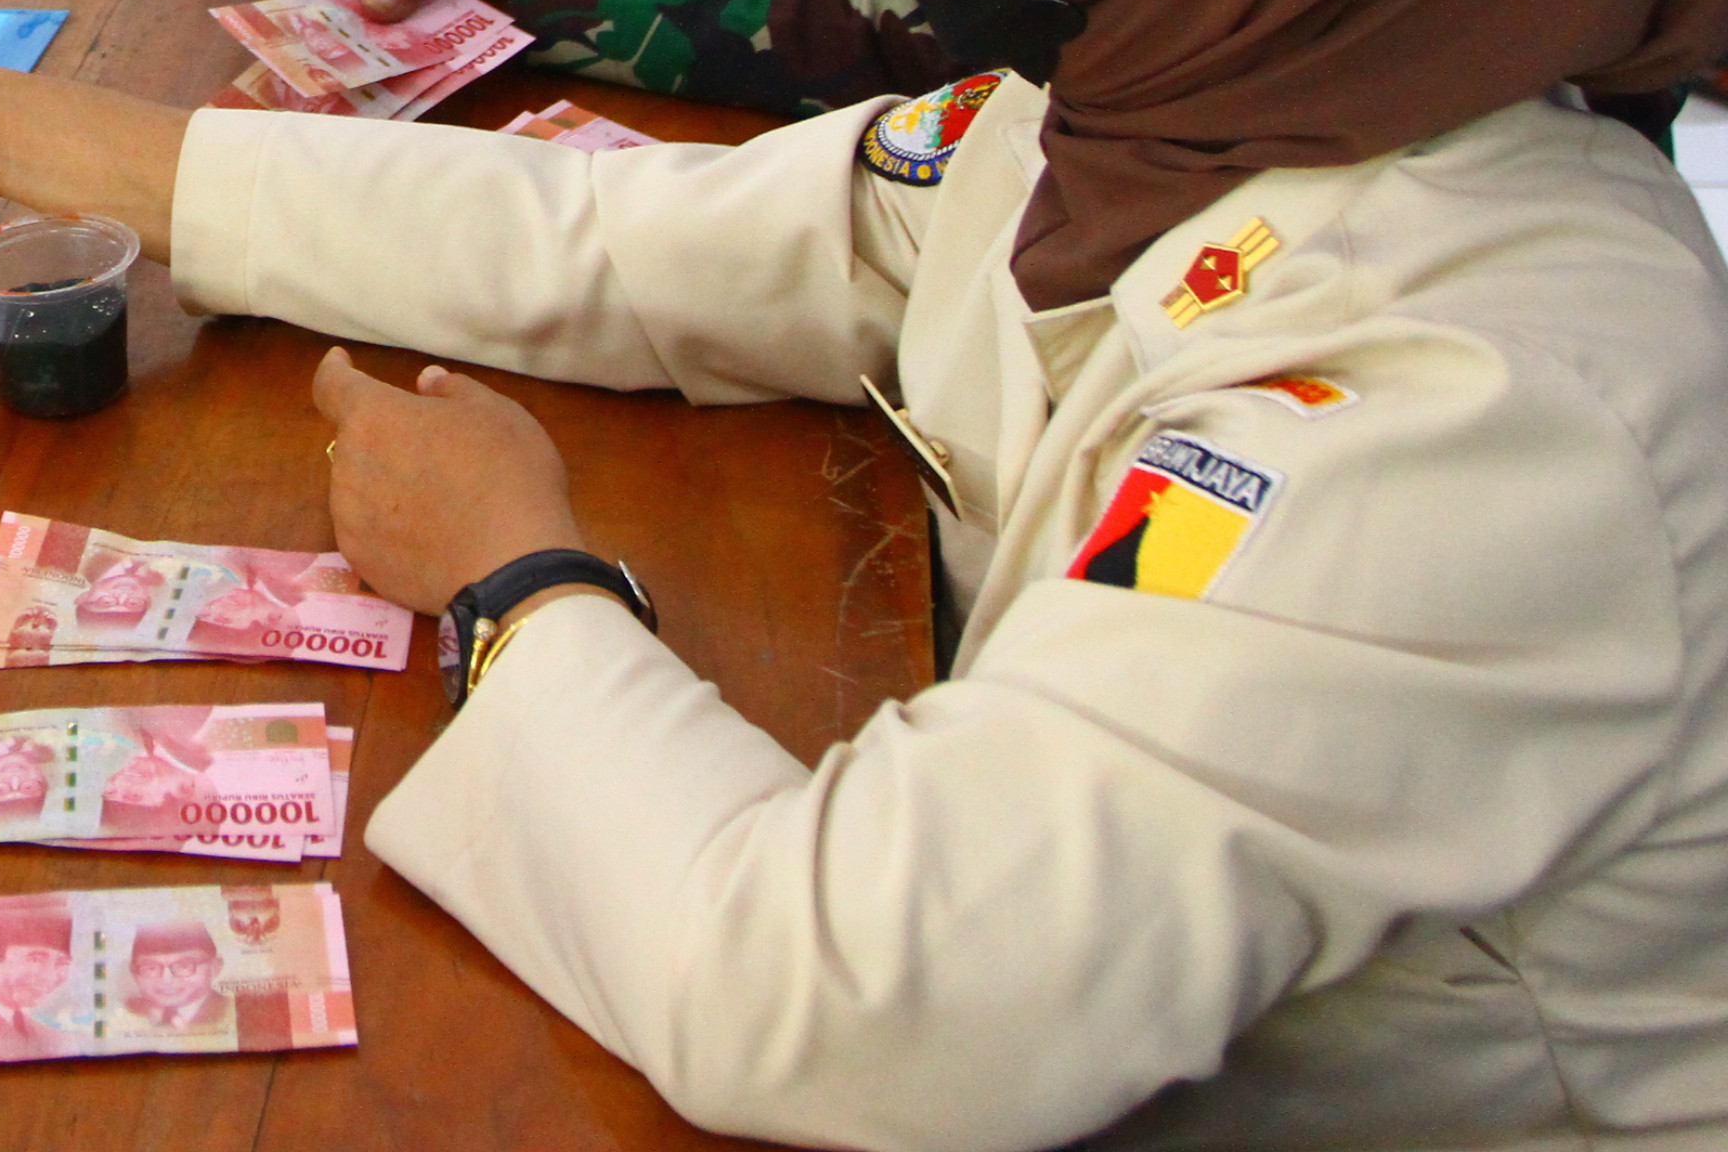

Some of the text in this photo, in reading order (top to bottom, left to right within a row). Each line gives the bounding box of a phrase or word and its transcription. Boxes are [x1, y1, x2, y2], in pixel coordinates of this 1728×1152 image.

[424, 14, 495, 54] 100000
[260, 629, 388, 659] 100000
[180, 800, 320, 825] 100000
